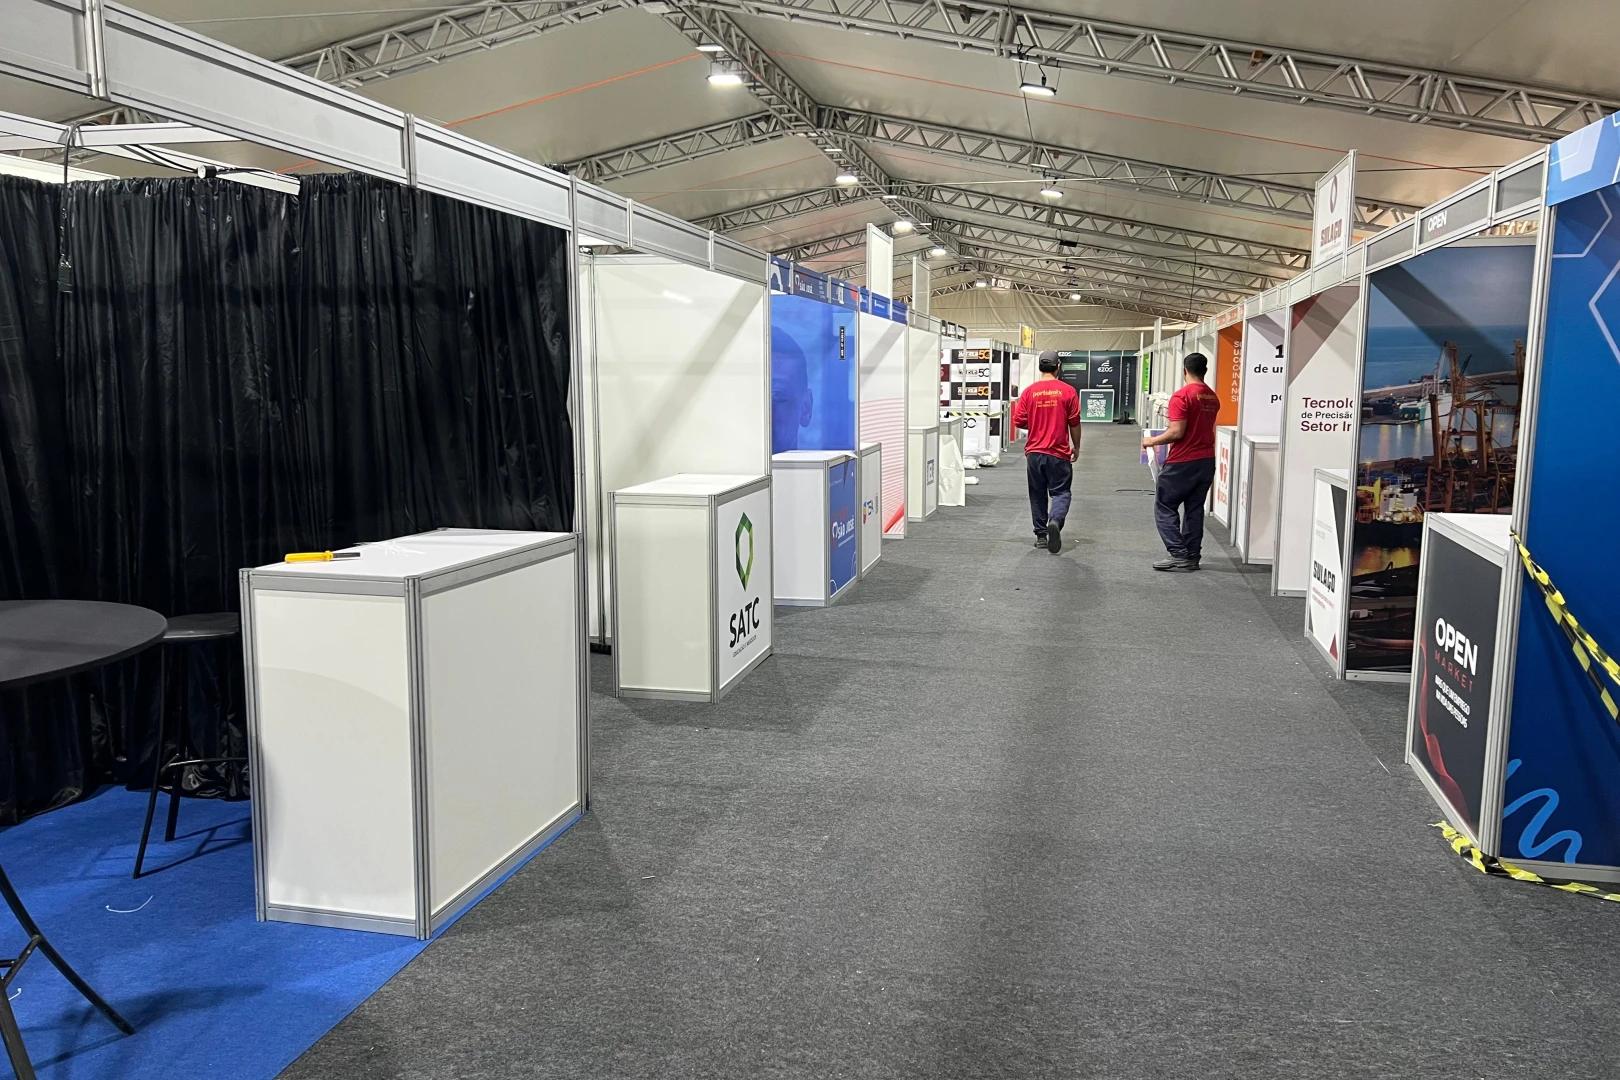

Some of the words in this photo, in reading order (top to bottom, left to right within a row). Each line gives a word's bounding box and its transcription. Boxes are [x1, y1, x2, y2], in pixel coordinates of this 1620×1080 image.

[1427, 211, 1447, 232] OPEN
[1253, 364, 1268, 374] de
[1300, 420, 1338, 432] Setor
[1301, 411, 1313, 419] de
[1313, 559, 1336, 594] SULAÇO
[729, 596, 760, 648] SATC
[1435, 617, 1478, 676] OPEN
[1434, 649, 1473, 693] MARKET
